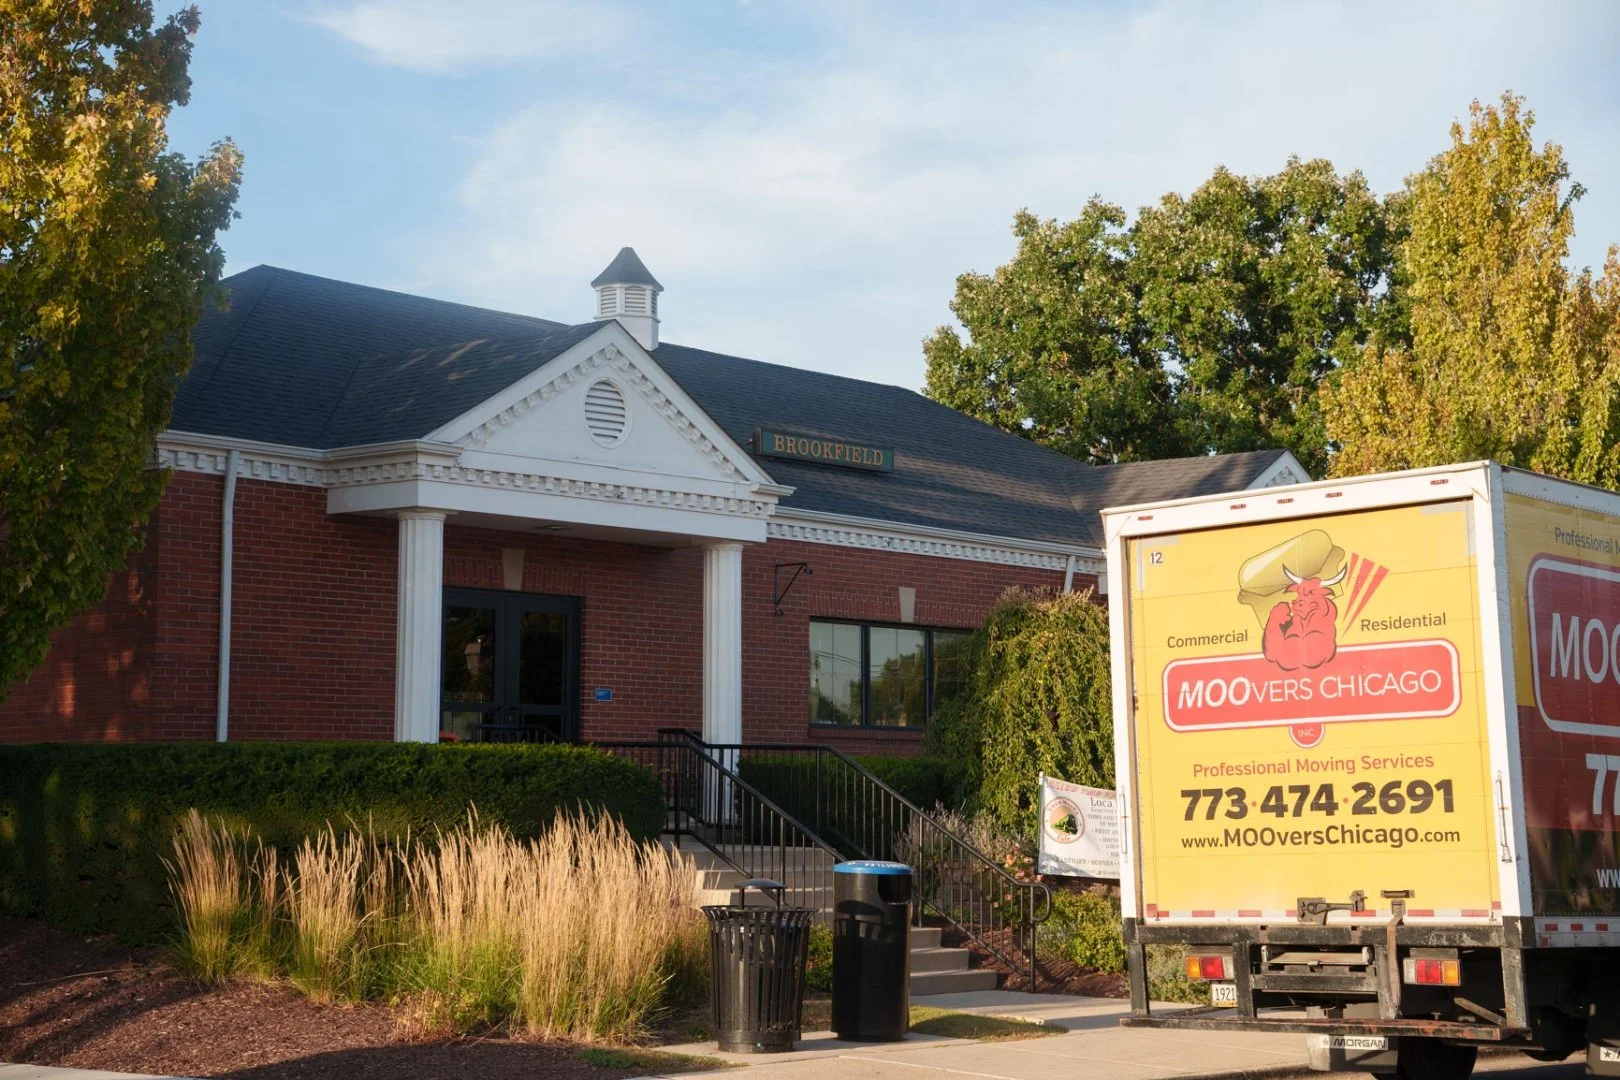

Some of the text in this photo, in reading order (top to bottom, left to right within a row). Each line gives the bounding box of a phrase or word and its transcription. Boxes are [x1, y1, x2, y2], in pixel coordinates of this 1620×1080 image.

[773, 434, 884, 466] BROOKFIELD
[1555, 526, 1613, 554] Professional
[1150, 551, 1164, 565] 12
[1360, 612, 1447, 632] Residential
[1167, 629, 1248, 649] Commercial
[1319, 669, 1442, 699] CHICAGO
[1297, 728, 1315, 738] INC
[1193, 753, 1435, 778] Professional Moving Services
[1181, 824, 1461, 849] www.MOOversChicago.com
[1333, 1038, 1386, 1049] MORGAN
